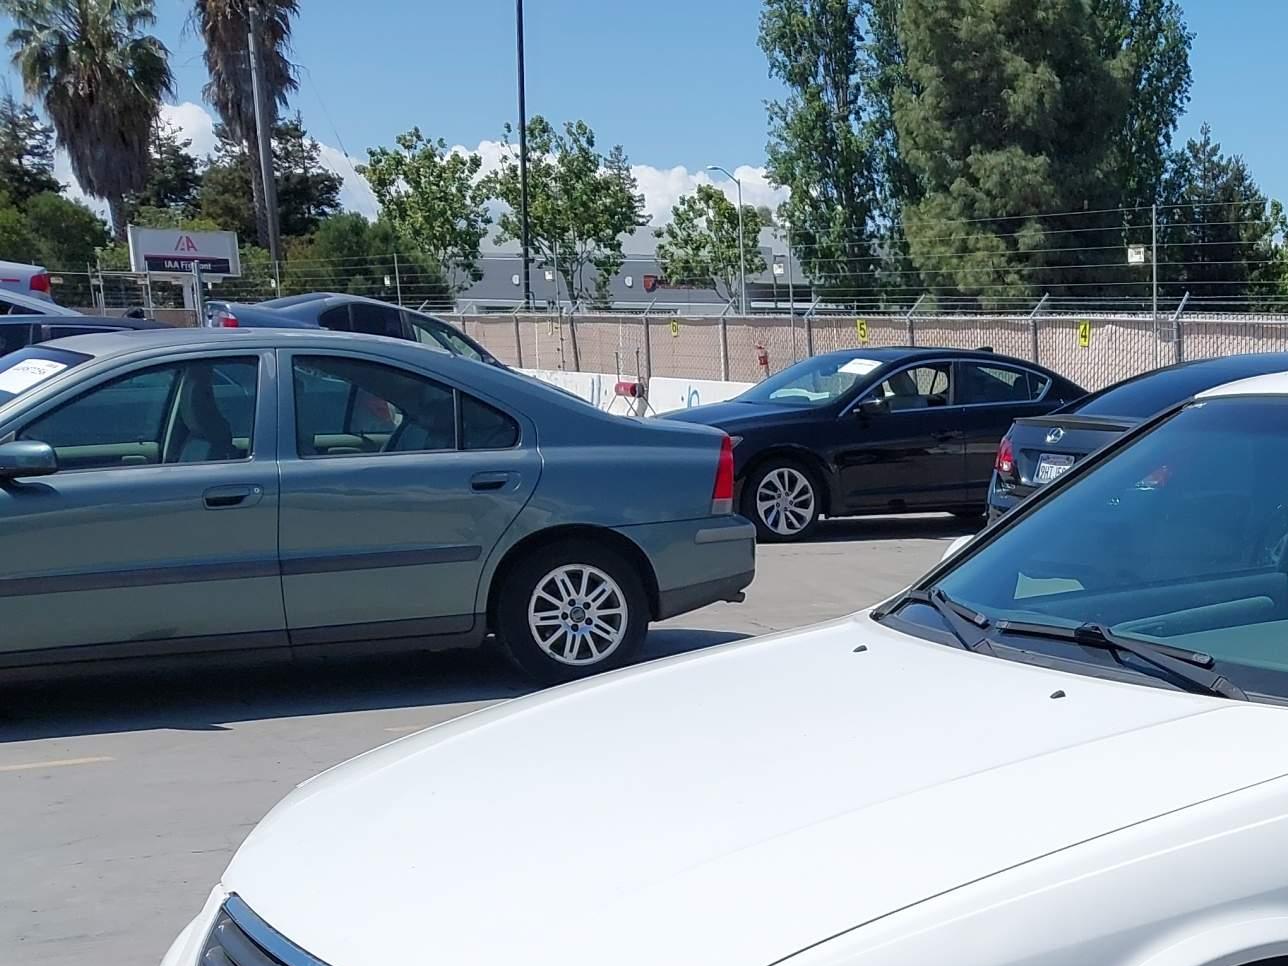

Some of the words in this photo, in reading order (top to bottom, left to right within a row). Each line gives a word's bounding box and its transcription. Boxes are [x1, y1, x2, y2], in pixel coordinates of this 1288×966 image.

[164, 260, 180, 269] IAA
[859, 322, 866, 338] 5
[1080, 323, 1088, 342] 4
